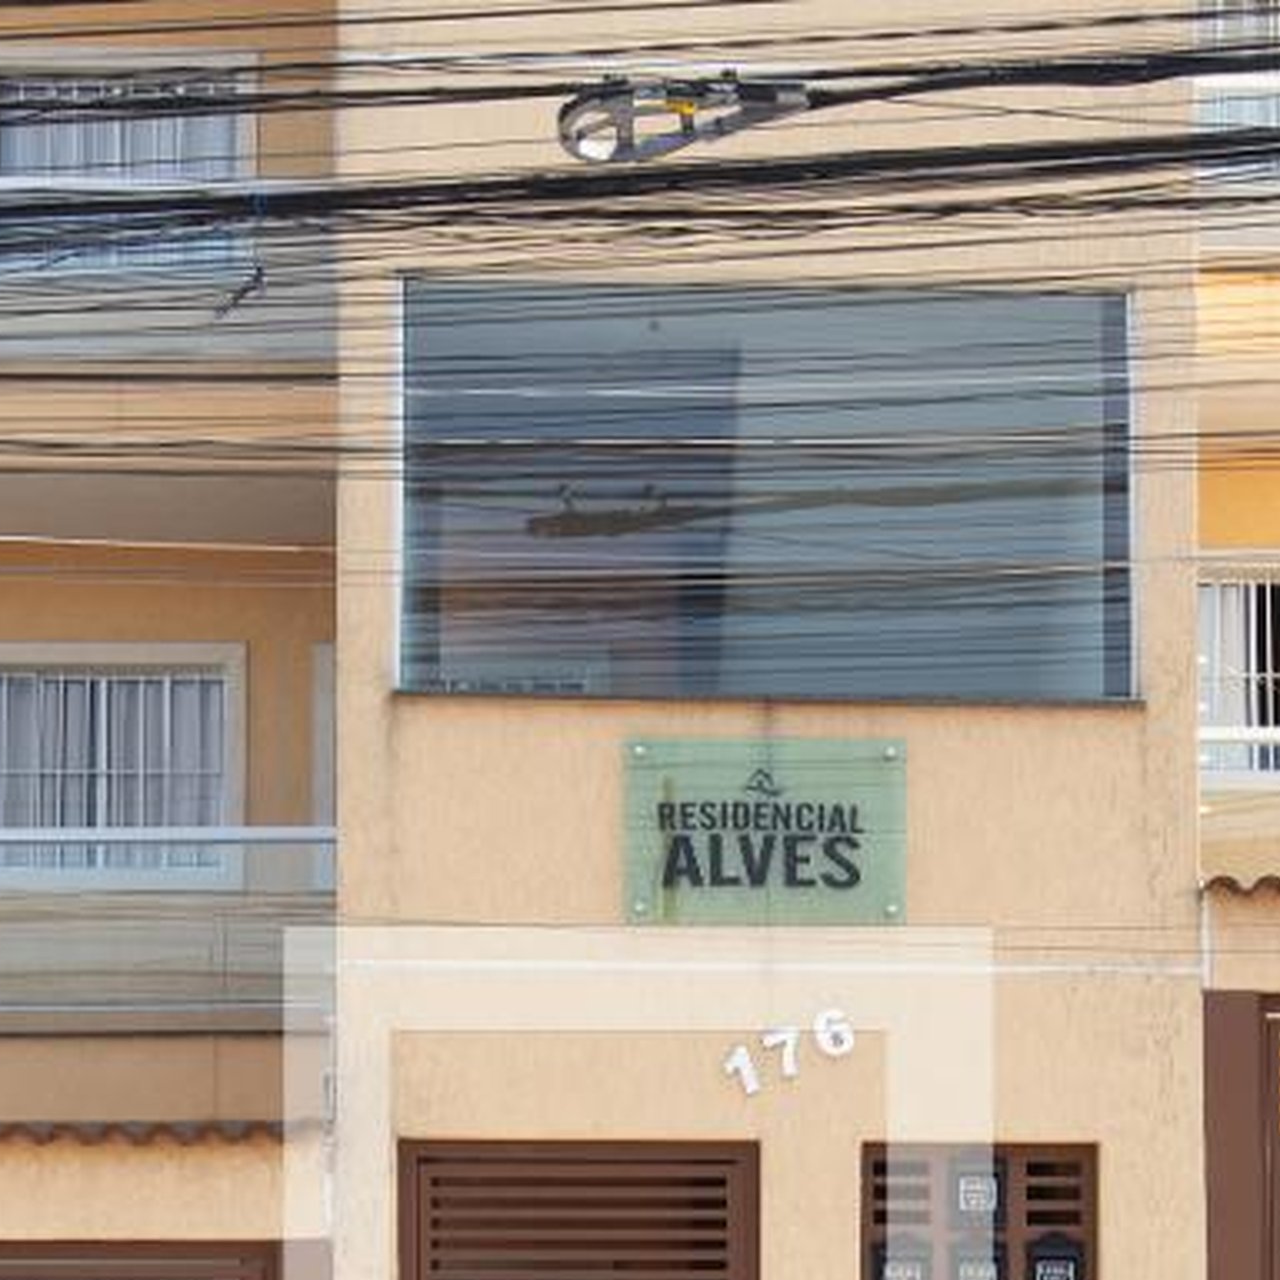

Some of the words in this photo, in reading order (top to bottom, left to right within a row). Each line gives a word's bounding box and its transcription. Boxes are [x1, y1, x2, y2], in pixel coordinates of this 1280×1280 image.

[657, 801, 865, 833] RESIDENCIAL
[662, 834, 861, 888] ALVES
[725, 1008, 854, 1096] 176
